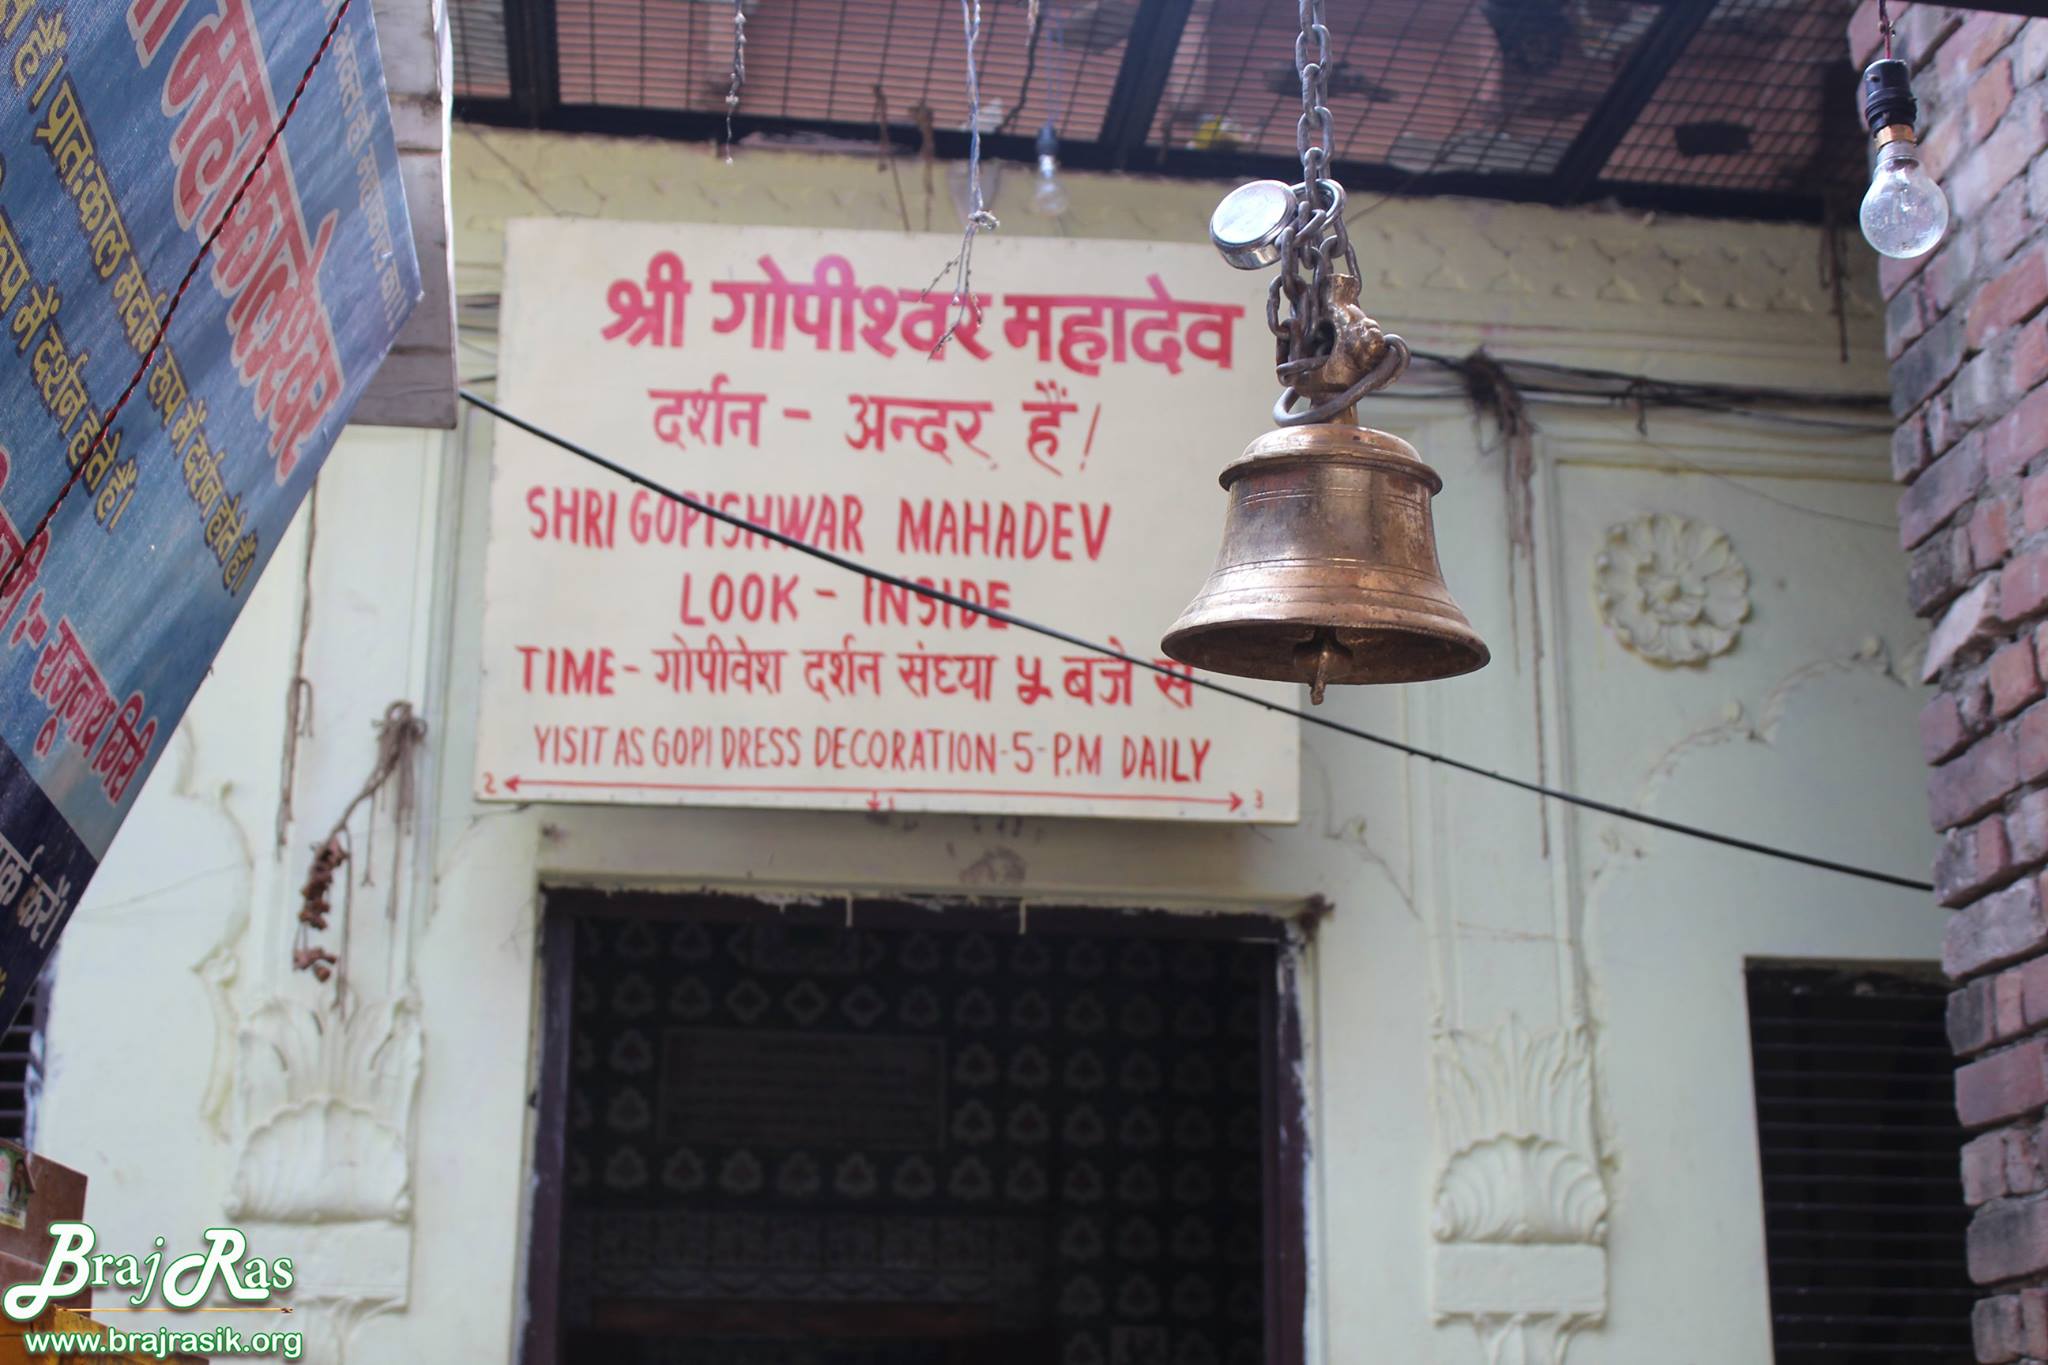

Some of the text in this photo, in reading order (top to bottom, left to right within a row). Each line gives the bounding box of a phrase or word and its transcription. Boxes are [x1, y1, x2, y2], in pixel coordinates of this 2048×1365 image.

[14, 286, 60, 350] में
[601, 250, 1246, 378] श्री गोपीश्वर महादेव
[33, 324, 88, 435] दर्शन
[149, 347, 188, 426] रूप
[647, 373, 769, 448] दर्शन
[847, 393, 994, 458] अन्दर
[172, 400, 206, 452] में
[184, 434, 224, 520] दर्शन
[206, 494, 246, 562] होते
[526, 486, 1113, 562] SHRI GOPISHWAR MAHADEV
[680, 572, 800, 628] LOOK
[863, 575, 1011, 631] INSIDE
[804, 633, 884, 696] दर्शन
[1062, 636, 1134, 706] बजे
[92, 692, 157, 803] गिरी
[615, 727, 644, 766] AS
[653, 726, 712, 768] GOPI
[721, 726, 801, 769] DRESS
[1121, 735, 1212, 784] DAILY
